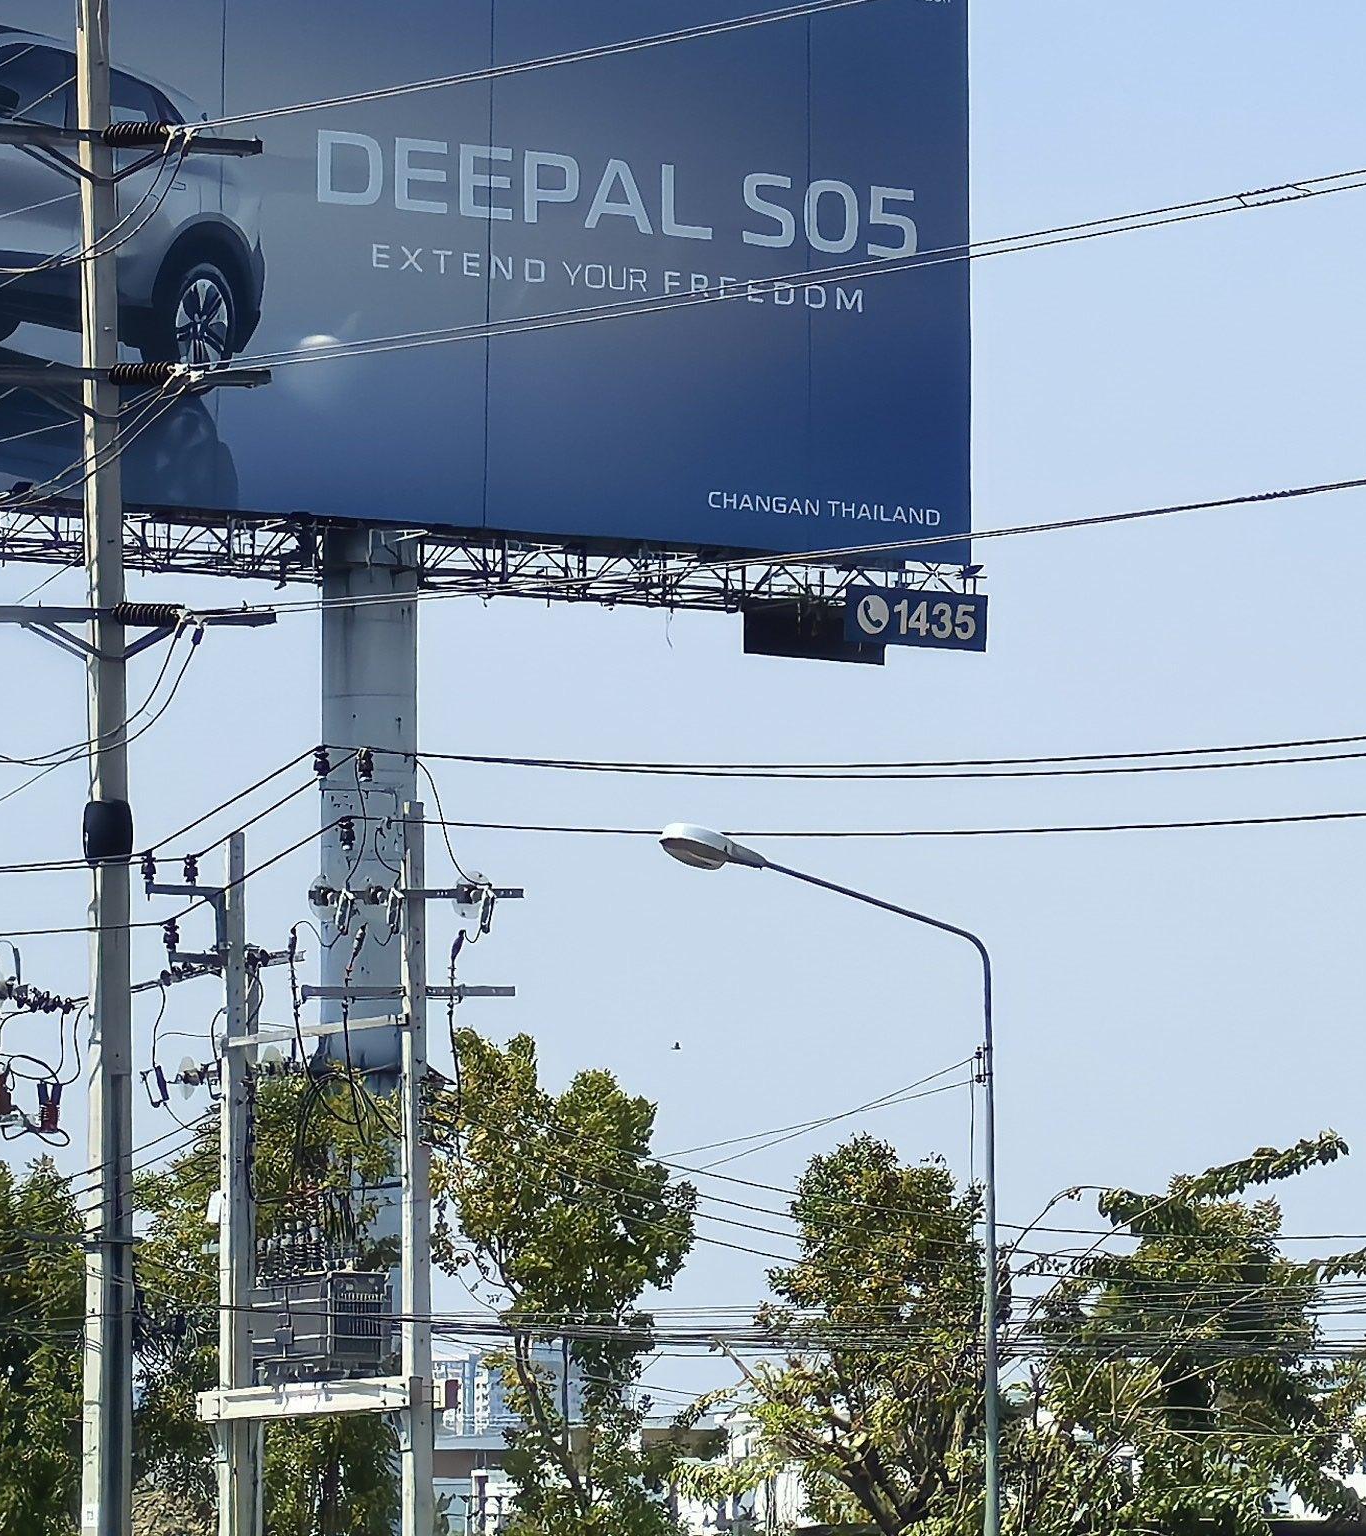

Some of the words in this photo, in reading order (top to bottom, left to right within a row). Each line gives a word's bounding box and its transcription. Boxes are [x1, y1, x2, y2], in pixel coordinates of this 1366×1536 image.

[316, 128, 713, 241] DEEPAL
[741, 171, 919, 260] S05
[371, 243, 546, 284] EXTEND
[562, 261, 649, 293] YOUR
[663, 271, 865, 314] FREEDOM
[707, 491, 820, 516] CHANGAN
[827, 500, 942, 527] THAILAND
[893, 598, 977, 641] 1435
